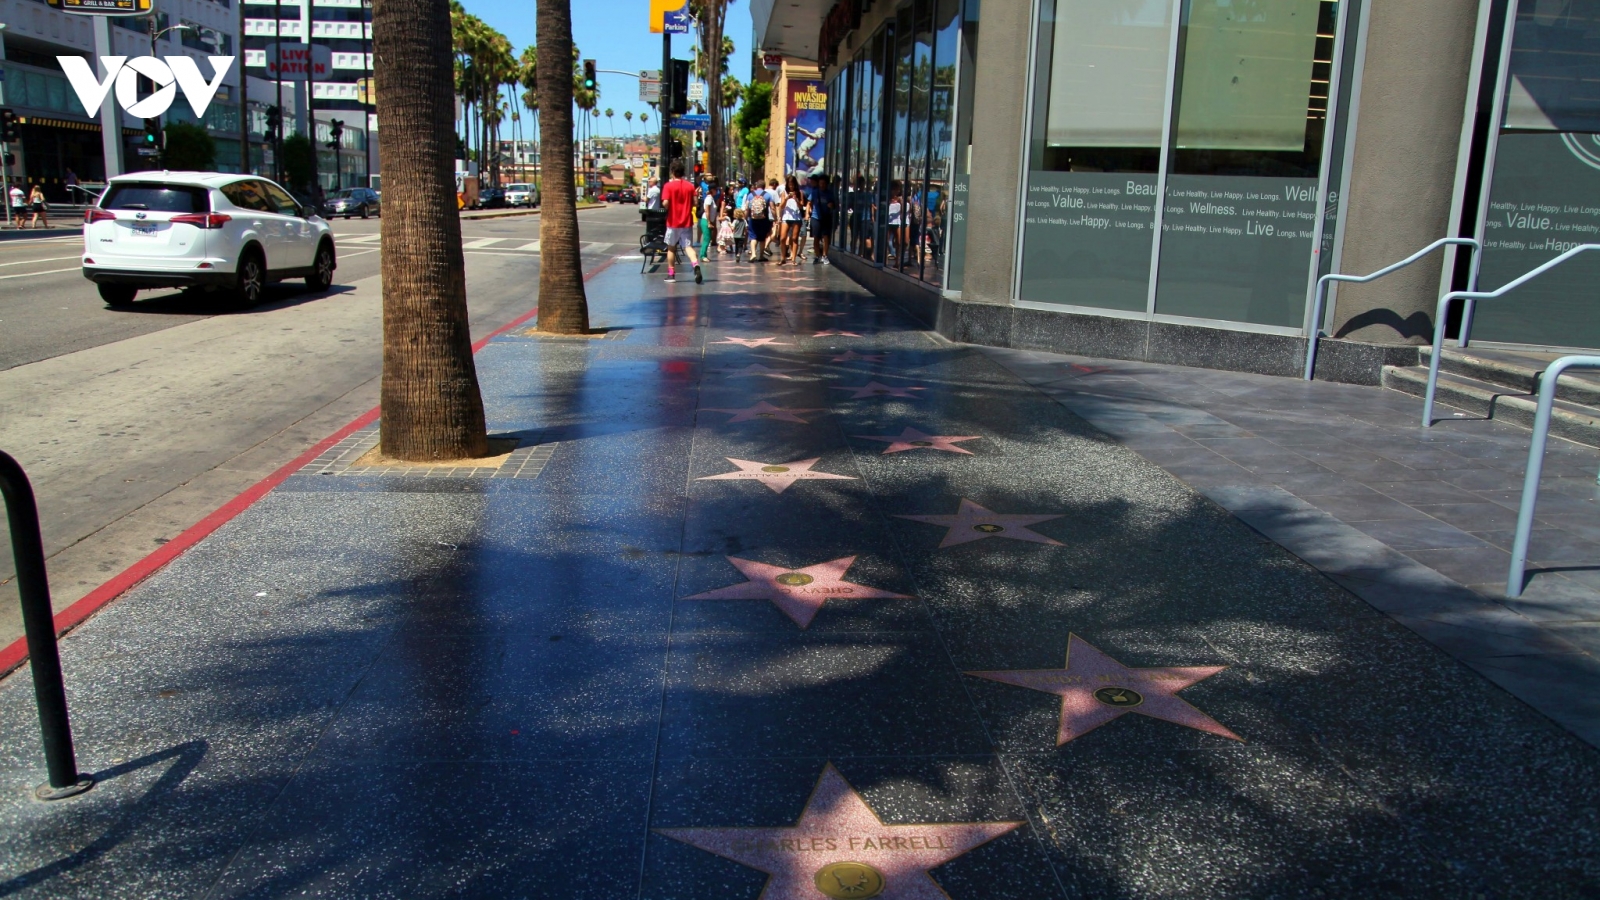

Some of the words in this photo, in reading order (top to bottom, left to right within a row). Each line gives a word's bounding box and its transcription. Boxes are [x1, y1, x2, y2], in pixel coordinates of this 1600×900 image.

[664, 23, 687, 32] Parking
[807, 85, 818, 93] THE
[1073, 186, 1091, 195] Happy.
[1173, 189, 1185, 197] Live
[1186, 190, 1209, 199] Healthy.
[1224, 191, 1245, 201] Happy.
[1246, 192, 1259, 200] Live
[1260, 192, 1281, 201] Longs.
[1052, 193, 1086, 209] Value.
[1121, 203, 1133, 211] Live
[1134, 204, 1153, 213] Happy.
[1189, 202, 1238, 216] Wellness.
[1242, 208, 1255, 216] Live
[1256, 209, 1280, 219] Healthy.
[1282, 210, 1296, 218] Live
[1490, 201, 1519, 212] Healthy.
[1520, 203, 1535, 211] Live
[1536, 203, 1562, 214] Happy.
[1563, 205, 1579, 213] Live
[1070, 218, 1080, 226] Live
[1080, 214, 1111, 230] Happy.
[1115, 220, 1126, 228] Live
[1127, 220, 1146, 230] Longs.
[1172, 223, 1184, 231] Live
[1185, 224, 1208, 234] Healthy.
[1209, 225, 1222, 233] Live
[1222, 226, 1244, 236] Happy.
[1246, 219, 1275, 236] Live
[1276, 229, 1298, 238] Longs.
[1506, 212, 1554, 230] Value.
[1555, 223, 1570, 231] Live
[1483, 239, 1498, 248] Live
[1499, 240, 1528, 250] Healthy.
[1529, 241, 1544, 250] Live
[799, 586, 854, 594] CHEVY
[849, 835, 952, 851] FARRELL
